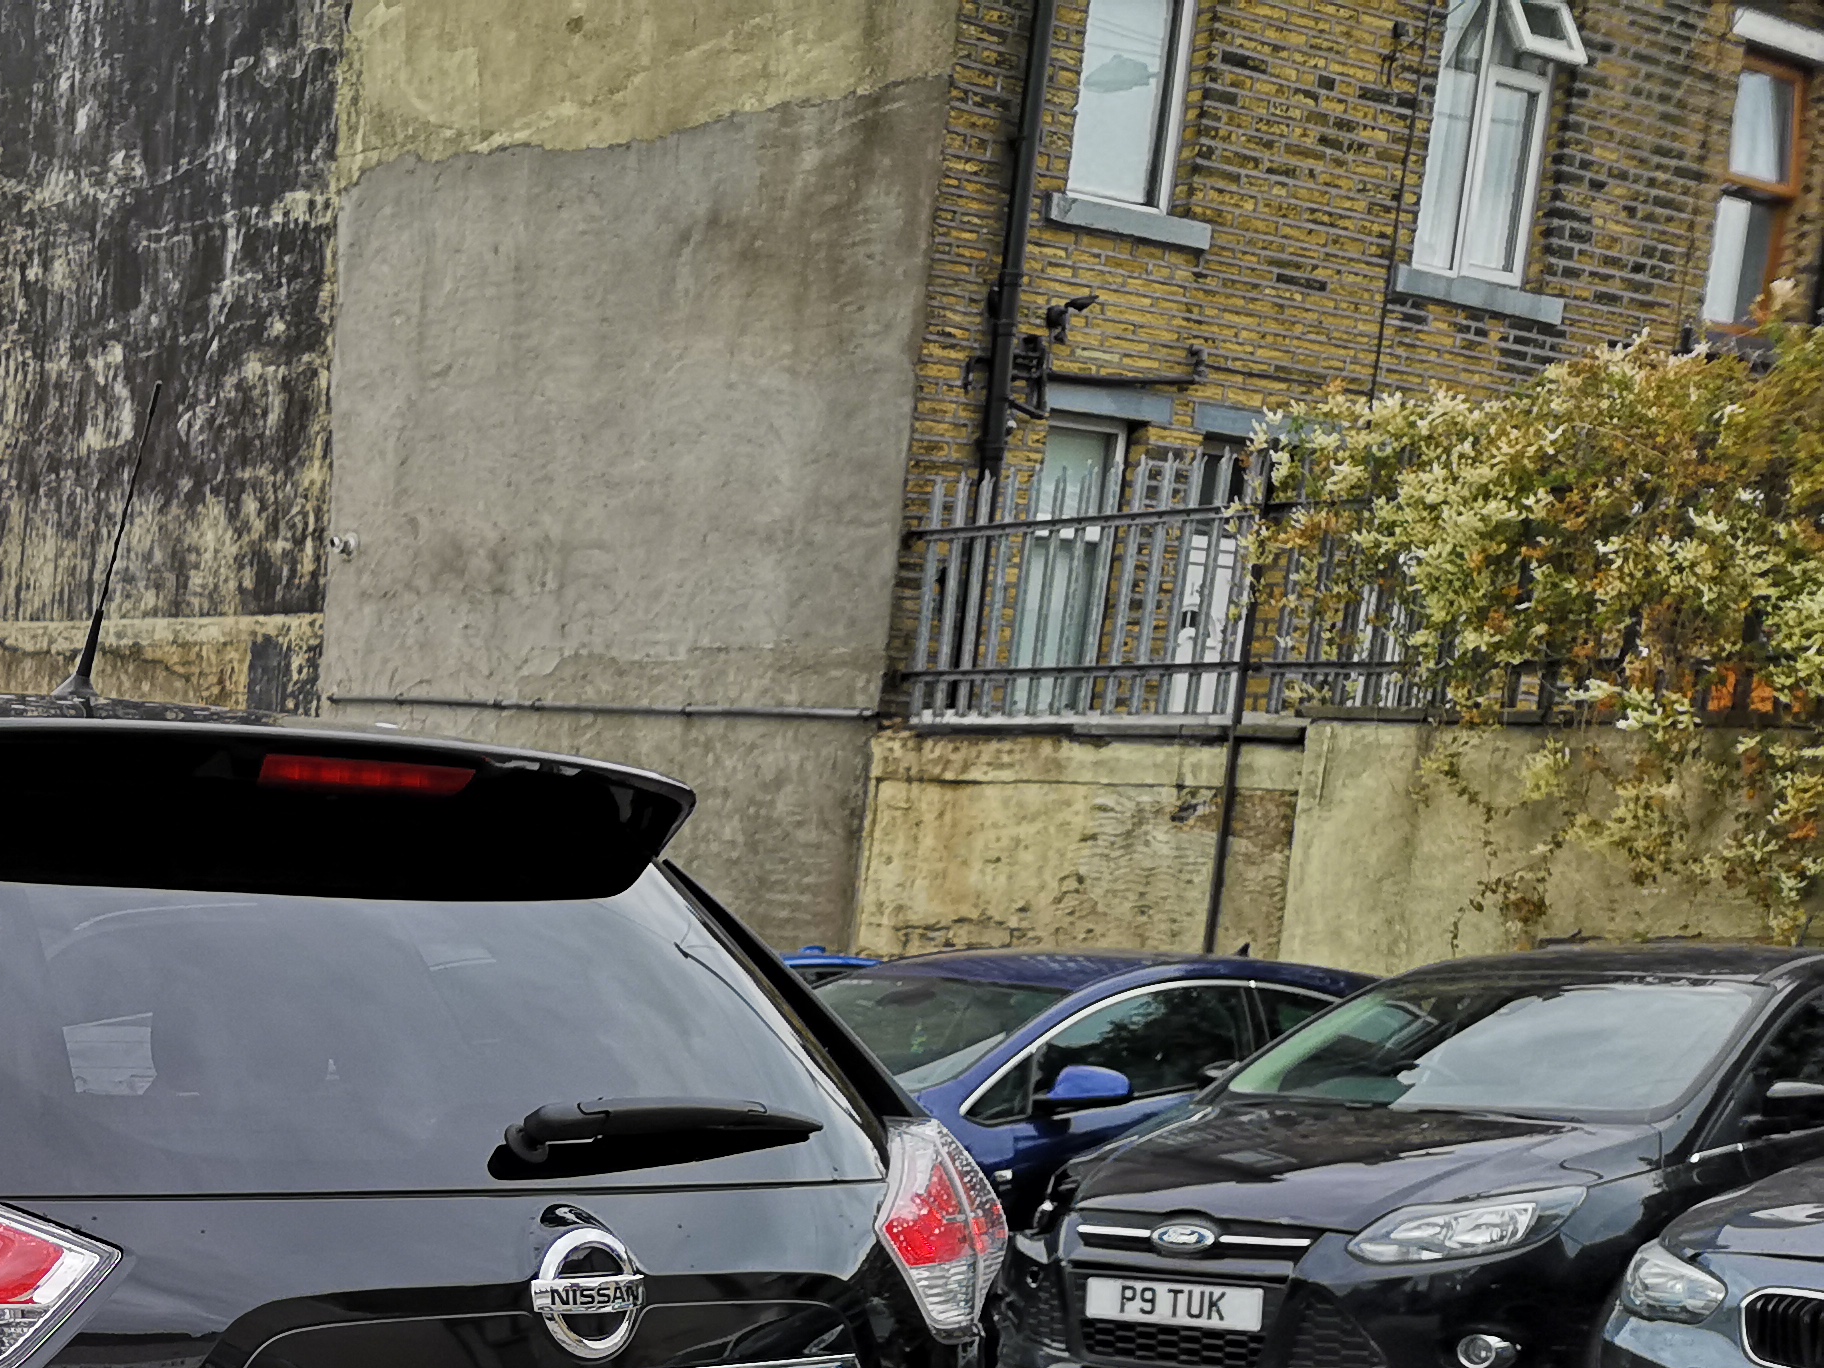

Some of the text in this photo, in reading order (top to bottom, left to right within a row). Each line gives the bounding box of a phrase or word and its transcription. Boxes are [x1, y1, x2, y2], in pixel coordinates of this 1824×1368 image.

[550, 1286, 640, 1306] NISSAN
[1119, 1285, 1226, 1321] P9 TUK
